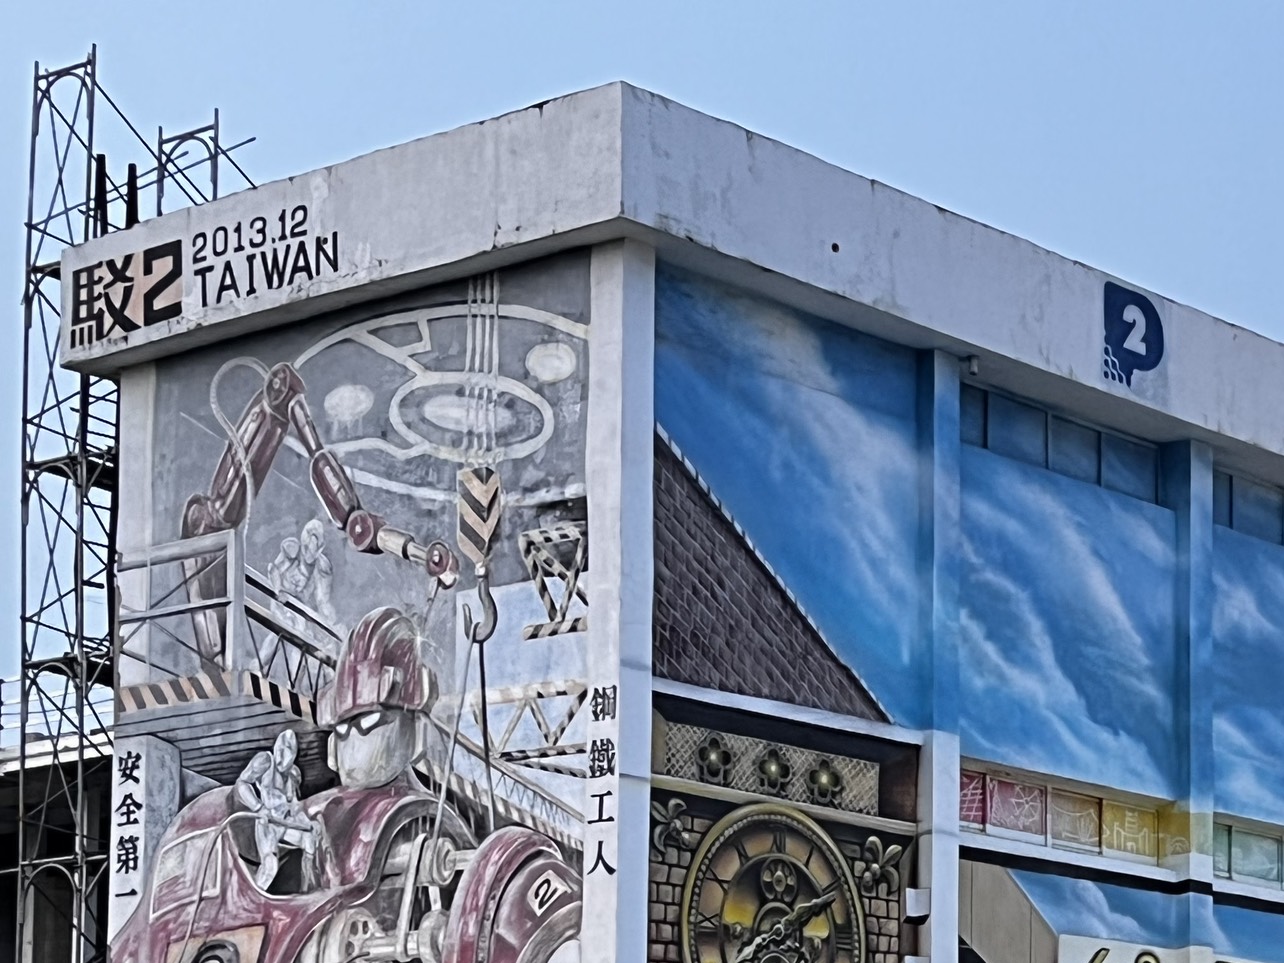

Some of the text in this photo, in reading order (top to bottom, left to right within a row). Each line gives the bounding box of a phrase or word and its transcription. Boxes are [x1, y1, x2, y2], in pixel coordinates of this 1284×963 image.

[192, 205, 308, 264] 2013.12
[194, 231, 339, 308] TAIWAN
[70, 239, 183, 349] 駁2
[114, 750, 143, 898] 安全第一
[534, 877, 559, 911] 2
